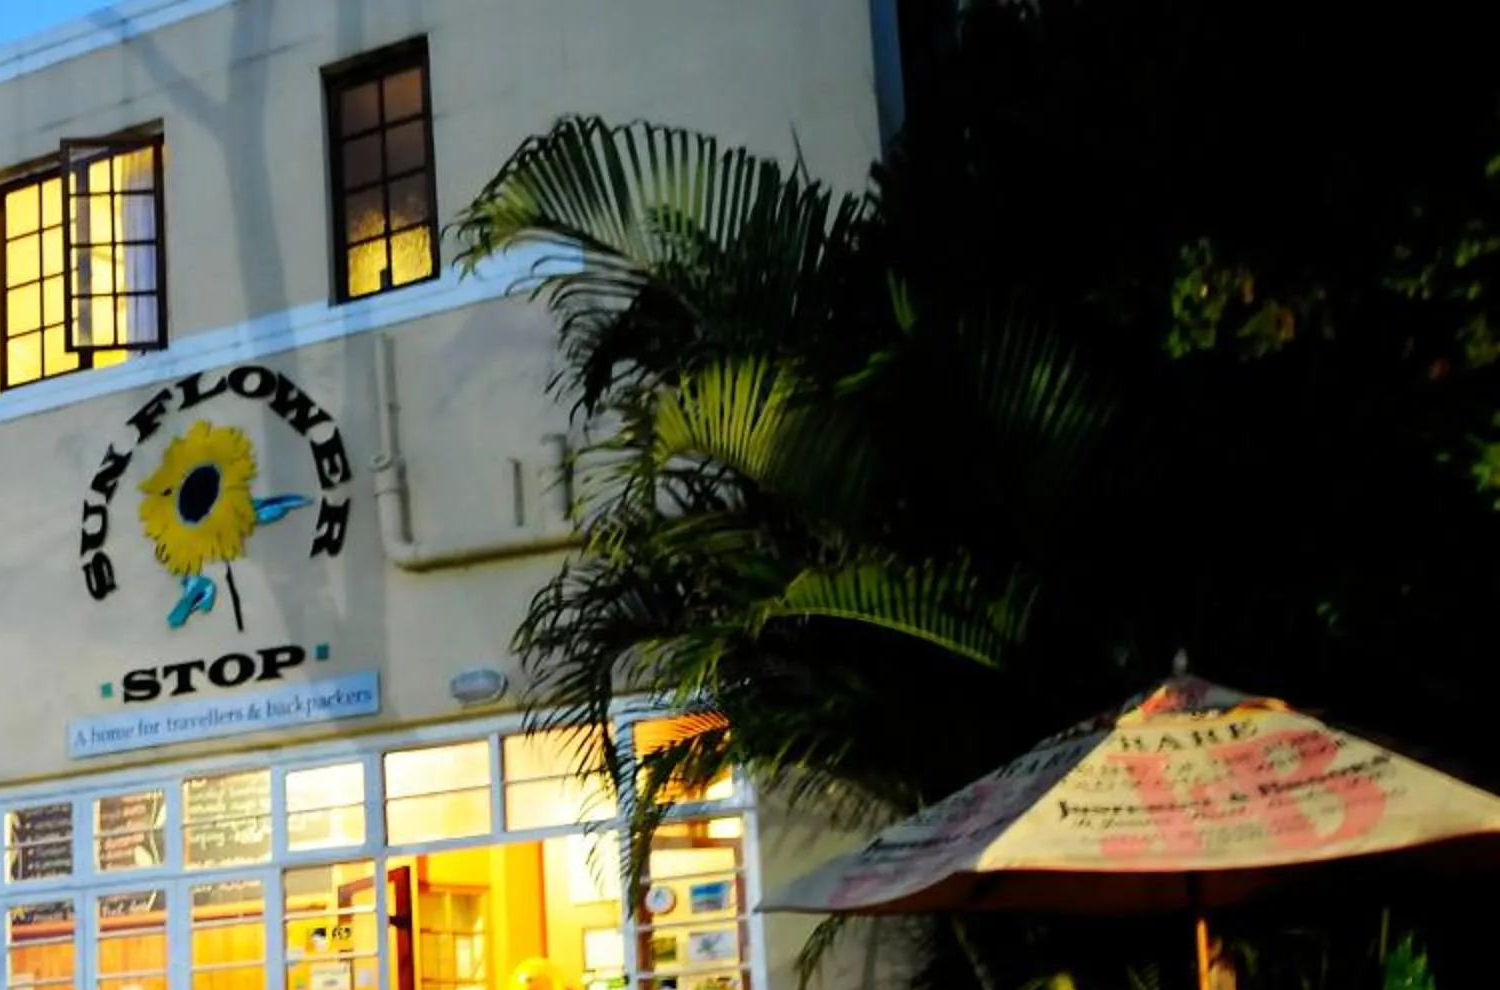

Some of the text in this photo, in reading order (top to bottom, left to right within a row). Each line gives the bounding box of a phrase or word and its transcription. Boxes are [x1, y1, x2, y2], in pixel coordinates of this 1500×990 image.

[80, 365, 354, 601] SUNFLOWER
[122, 644, 306, 703] STOP
[74, 731, 87, 747] A
[91, 725, 132, 744] home
[137, 717, 160, 736] for
[166, 707, 243, 732] travellers
[245, 705, 261, 721] &
